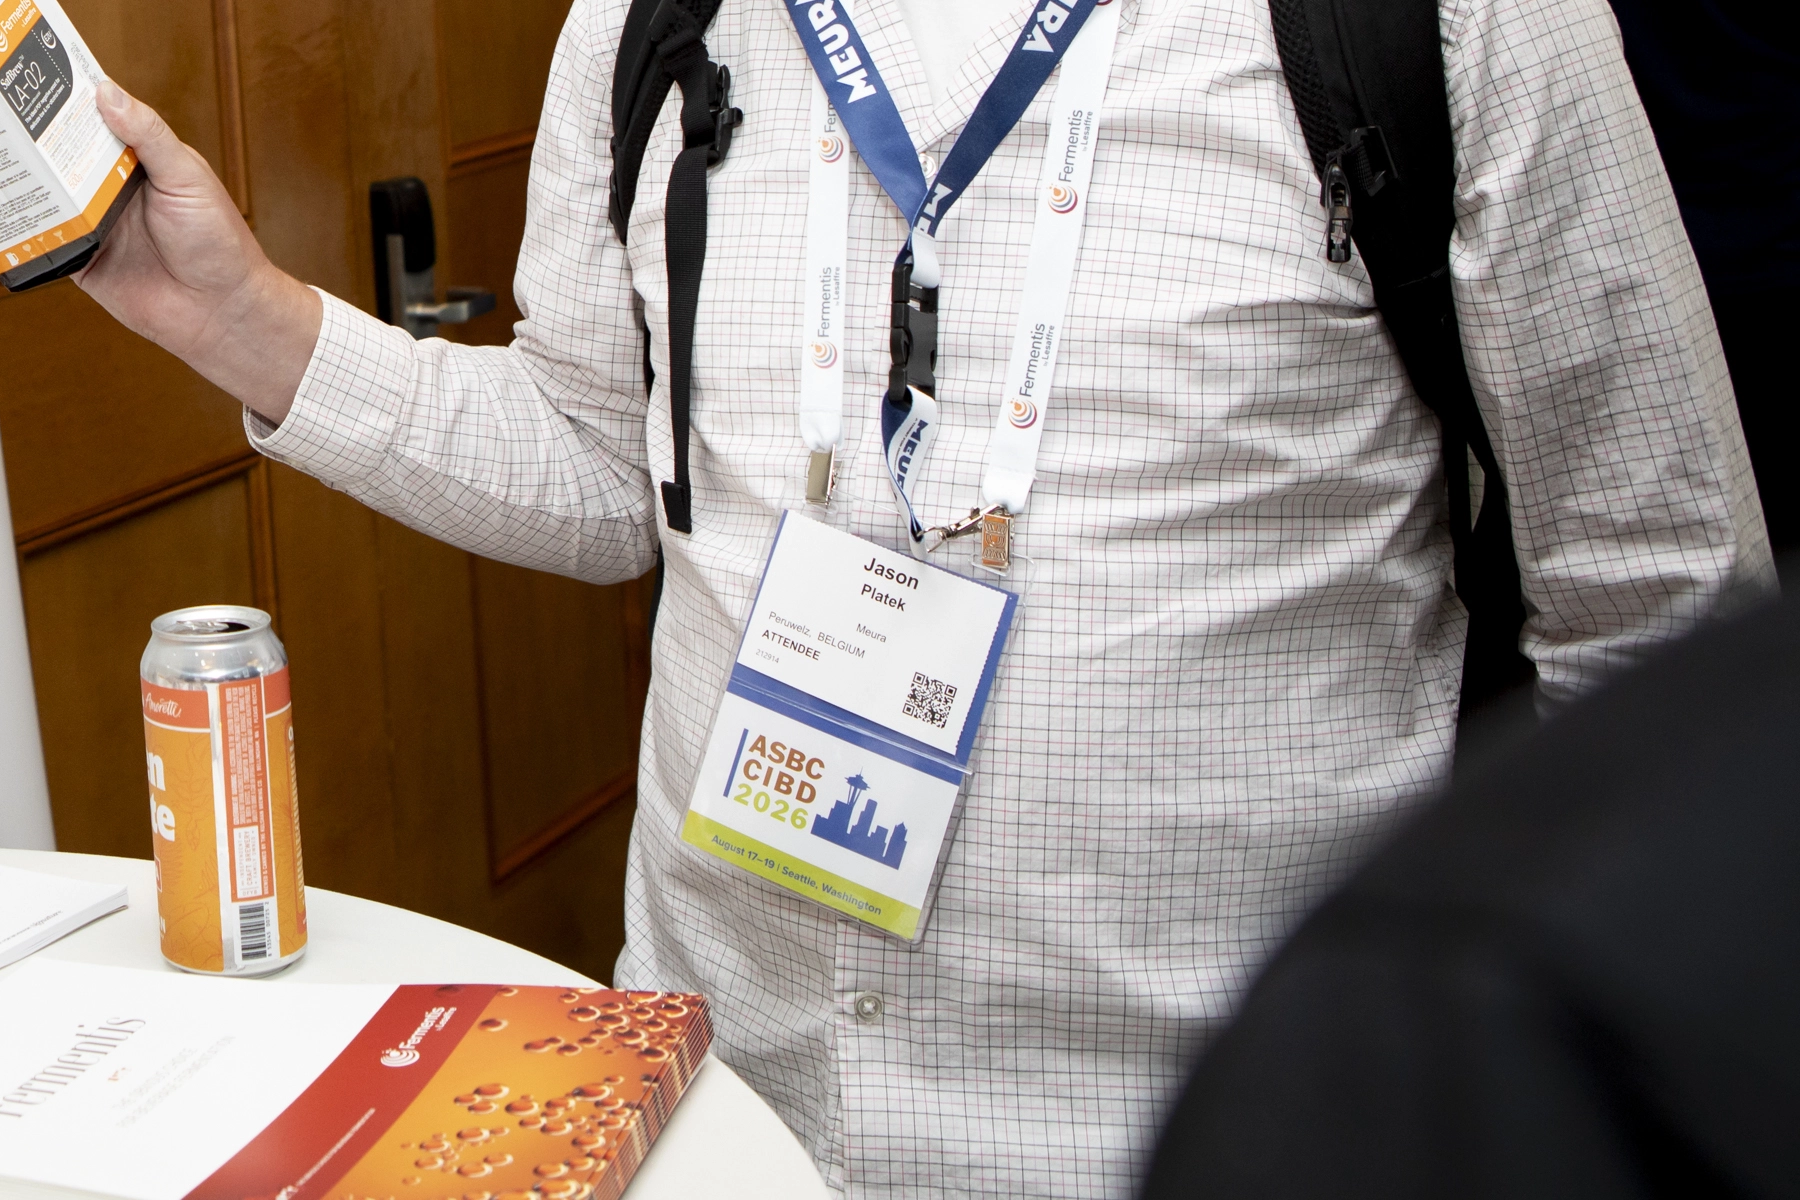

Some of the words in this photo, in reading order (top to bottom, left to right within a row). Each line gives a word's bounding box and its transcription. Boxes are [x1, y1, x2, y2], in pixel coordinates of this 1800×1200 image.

[7, 61, 46, 112] LA-02
[1058, 109, 1083, 182] Fermentis
[1083, 110, 1093, 146] Lesaffre
[817, 266, 832, 338] Fermentis
[833, 267, 841, 300] Lesaffre
[1019, 322, 1045, 397] Fermentis
[1042, 325, 1055, 360] Lesaffre
[897, 419, 928, 490] MEU
[864, 557, 919, 590] Jason
[861, 583, 906, 612] Platek
[755, 648, 780, 664] 212914
[761, 629, 821, 661] ATTENDEE
[768, 611, 812, 638] Peruwelz,
[817, 631, 865, 659] BELGIUM
[856, 623, 887, 643] Meura
[748, 735, 826, 781] ASBC
[742, 759, 817, 805] CIBD
[733, 784, 808, 830] 2026
[711, 834, 746, 860] August
[782, 864, 819, 890] Seattle,
[821, 880, 882, 916] Washington
[399, 1006, 444, 1049] Fermentis
